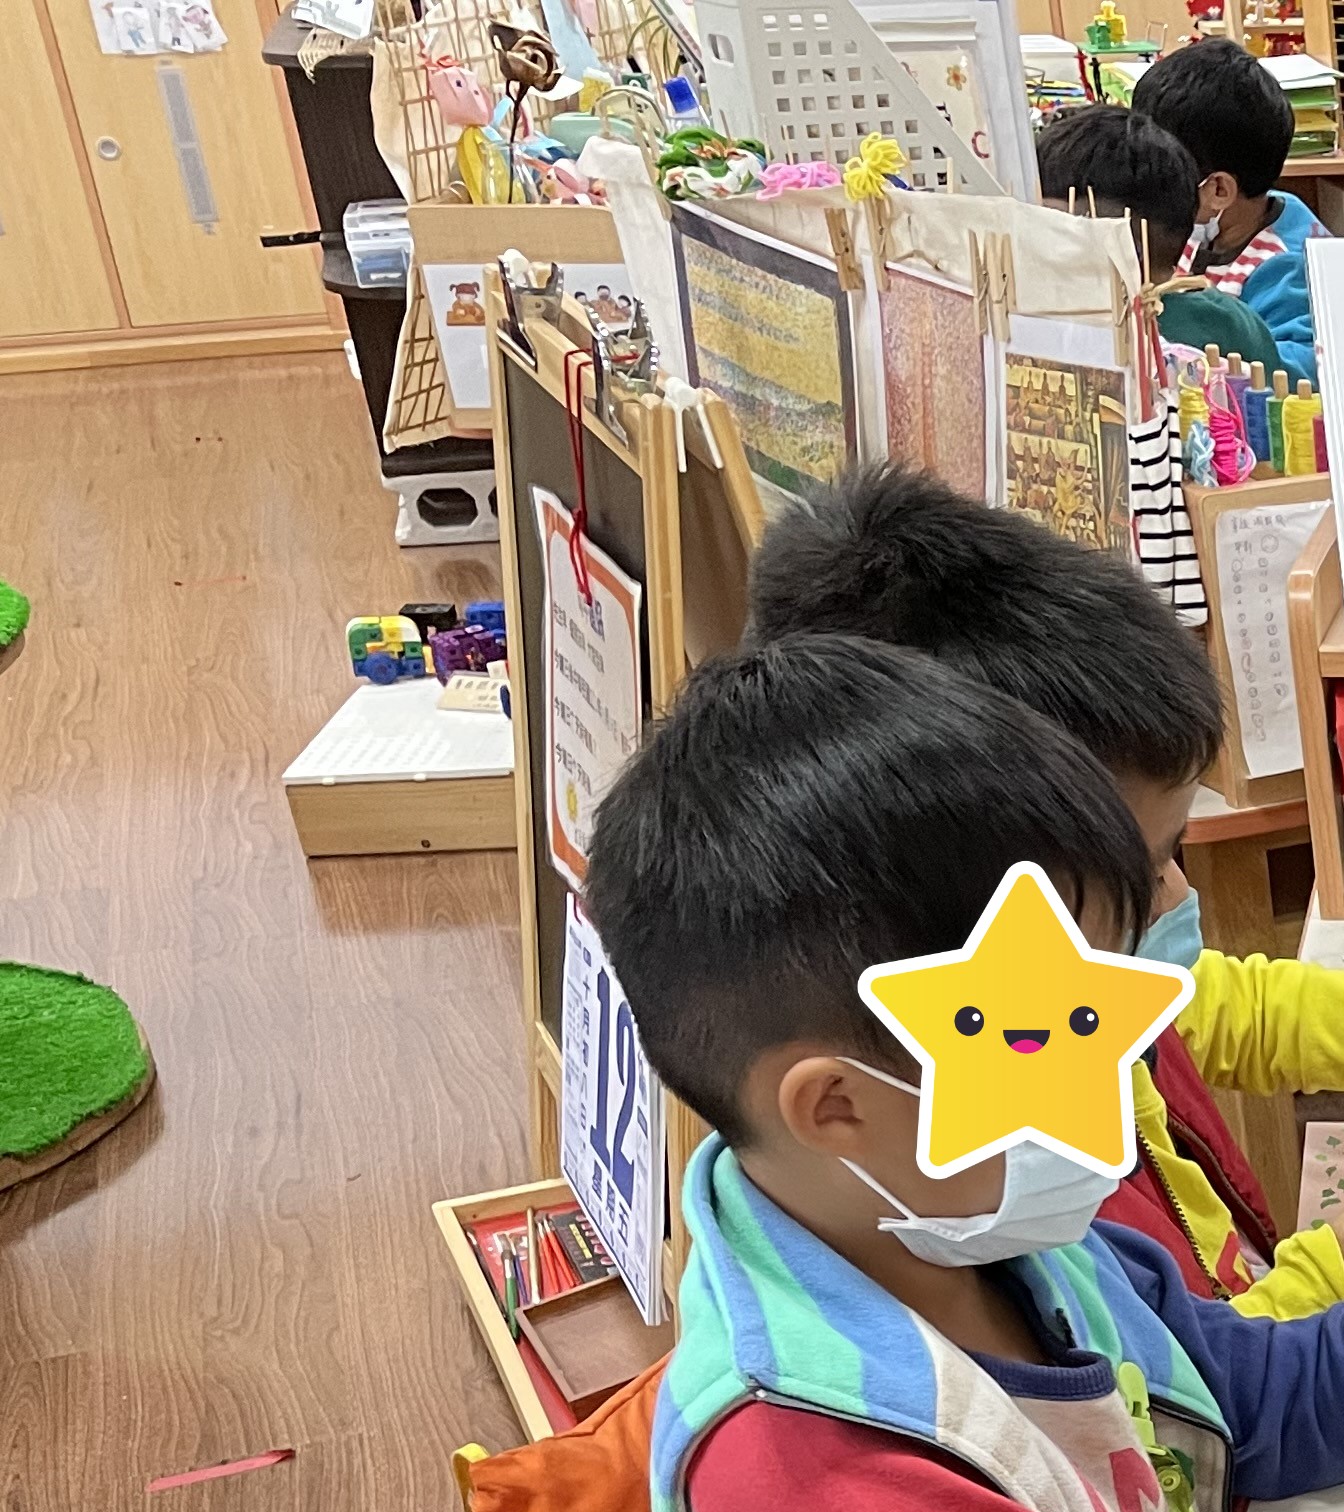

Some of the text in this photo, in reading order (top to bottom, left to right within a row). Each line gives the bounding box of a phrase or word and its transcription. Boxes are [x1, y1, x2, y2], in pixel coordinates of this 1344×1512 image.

[590, 965, 636, 1212] 12
[592, 1159, 629, 1249] 星期五
